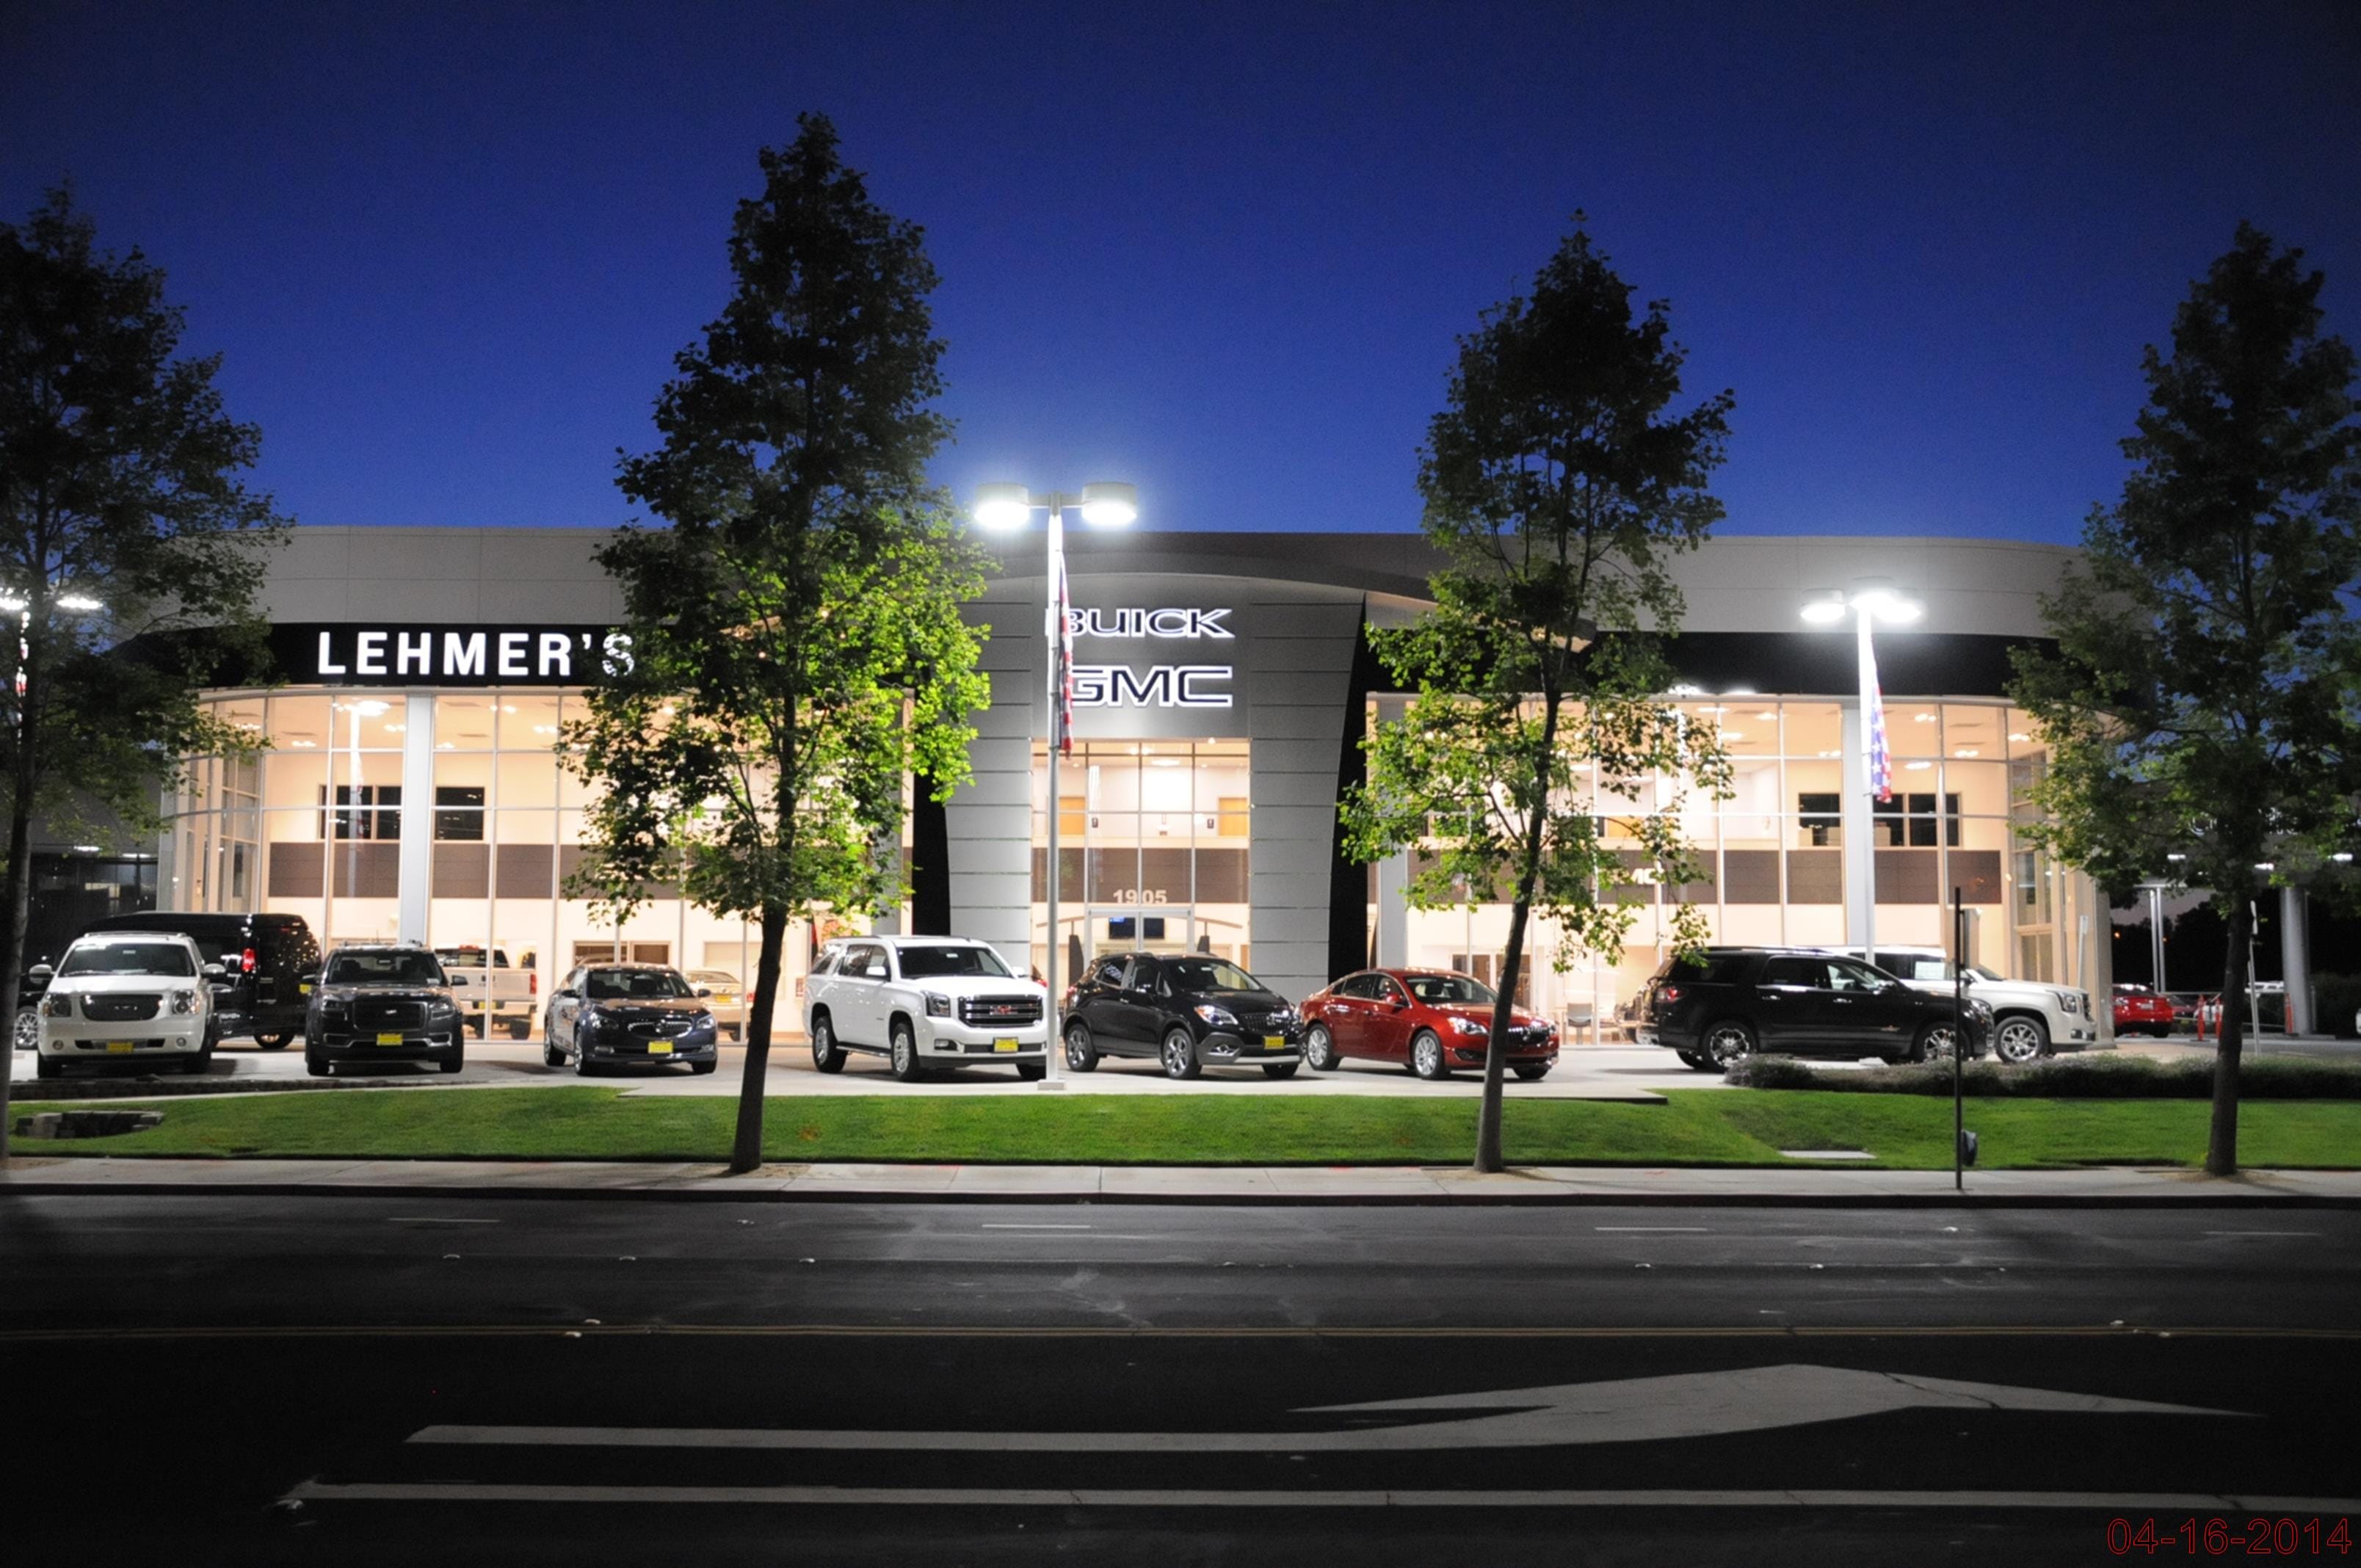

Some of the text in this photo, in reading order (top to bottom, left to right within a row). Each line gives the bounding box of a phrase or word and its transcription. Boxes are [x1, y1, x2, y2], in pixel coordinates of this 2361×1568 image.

[1045, 609, 1236, 638] BUICK
[318, 631, 635, 677] LEHMER'S
[1070, 665, 1233, 707] GMC
[1113, 889, 1167, 904] 1905
